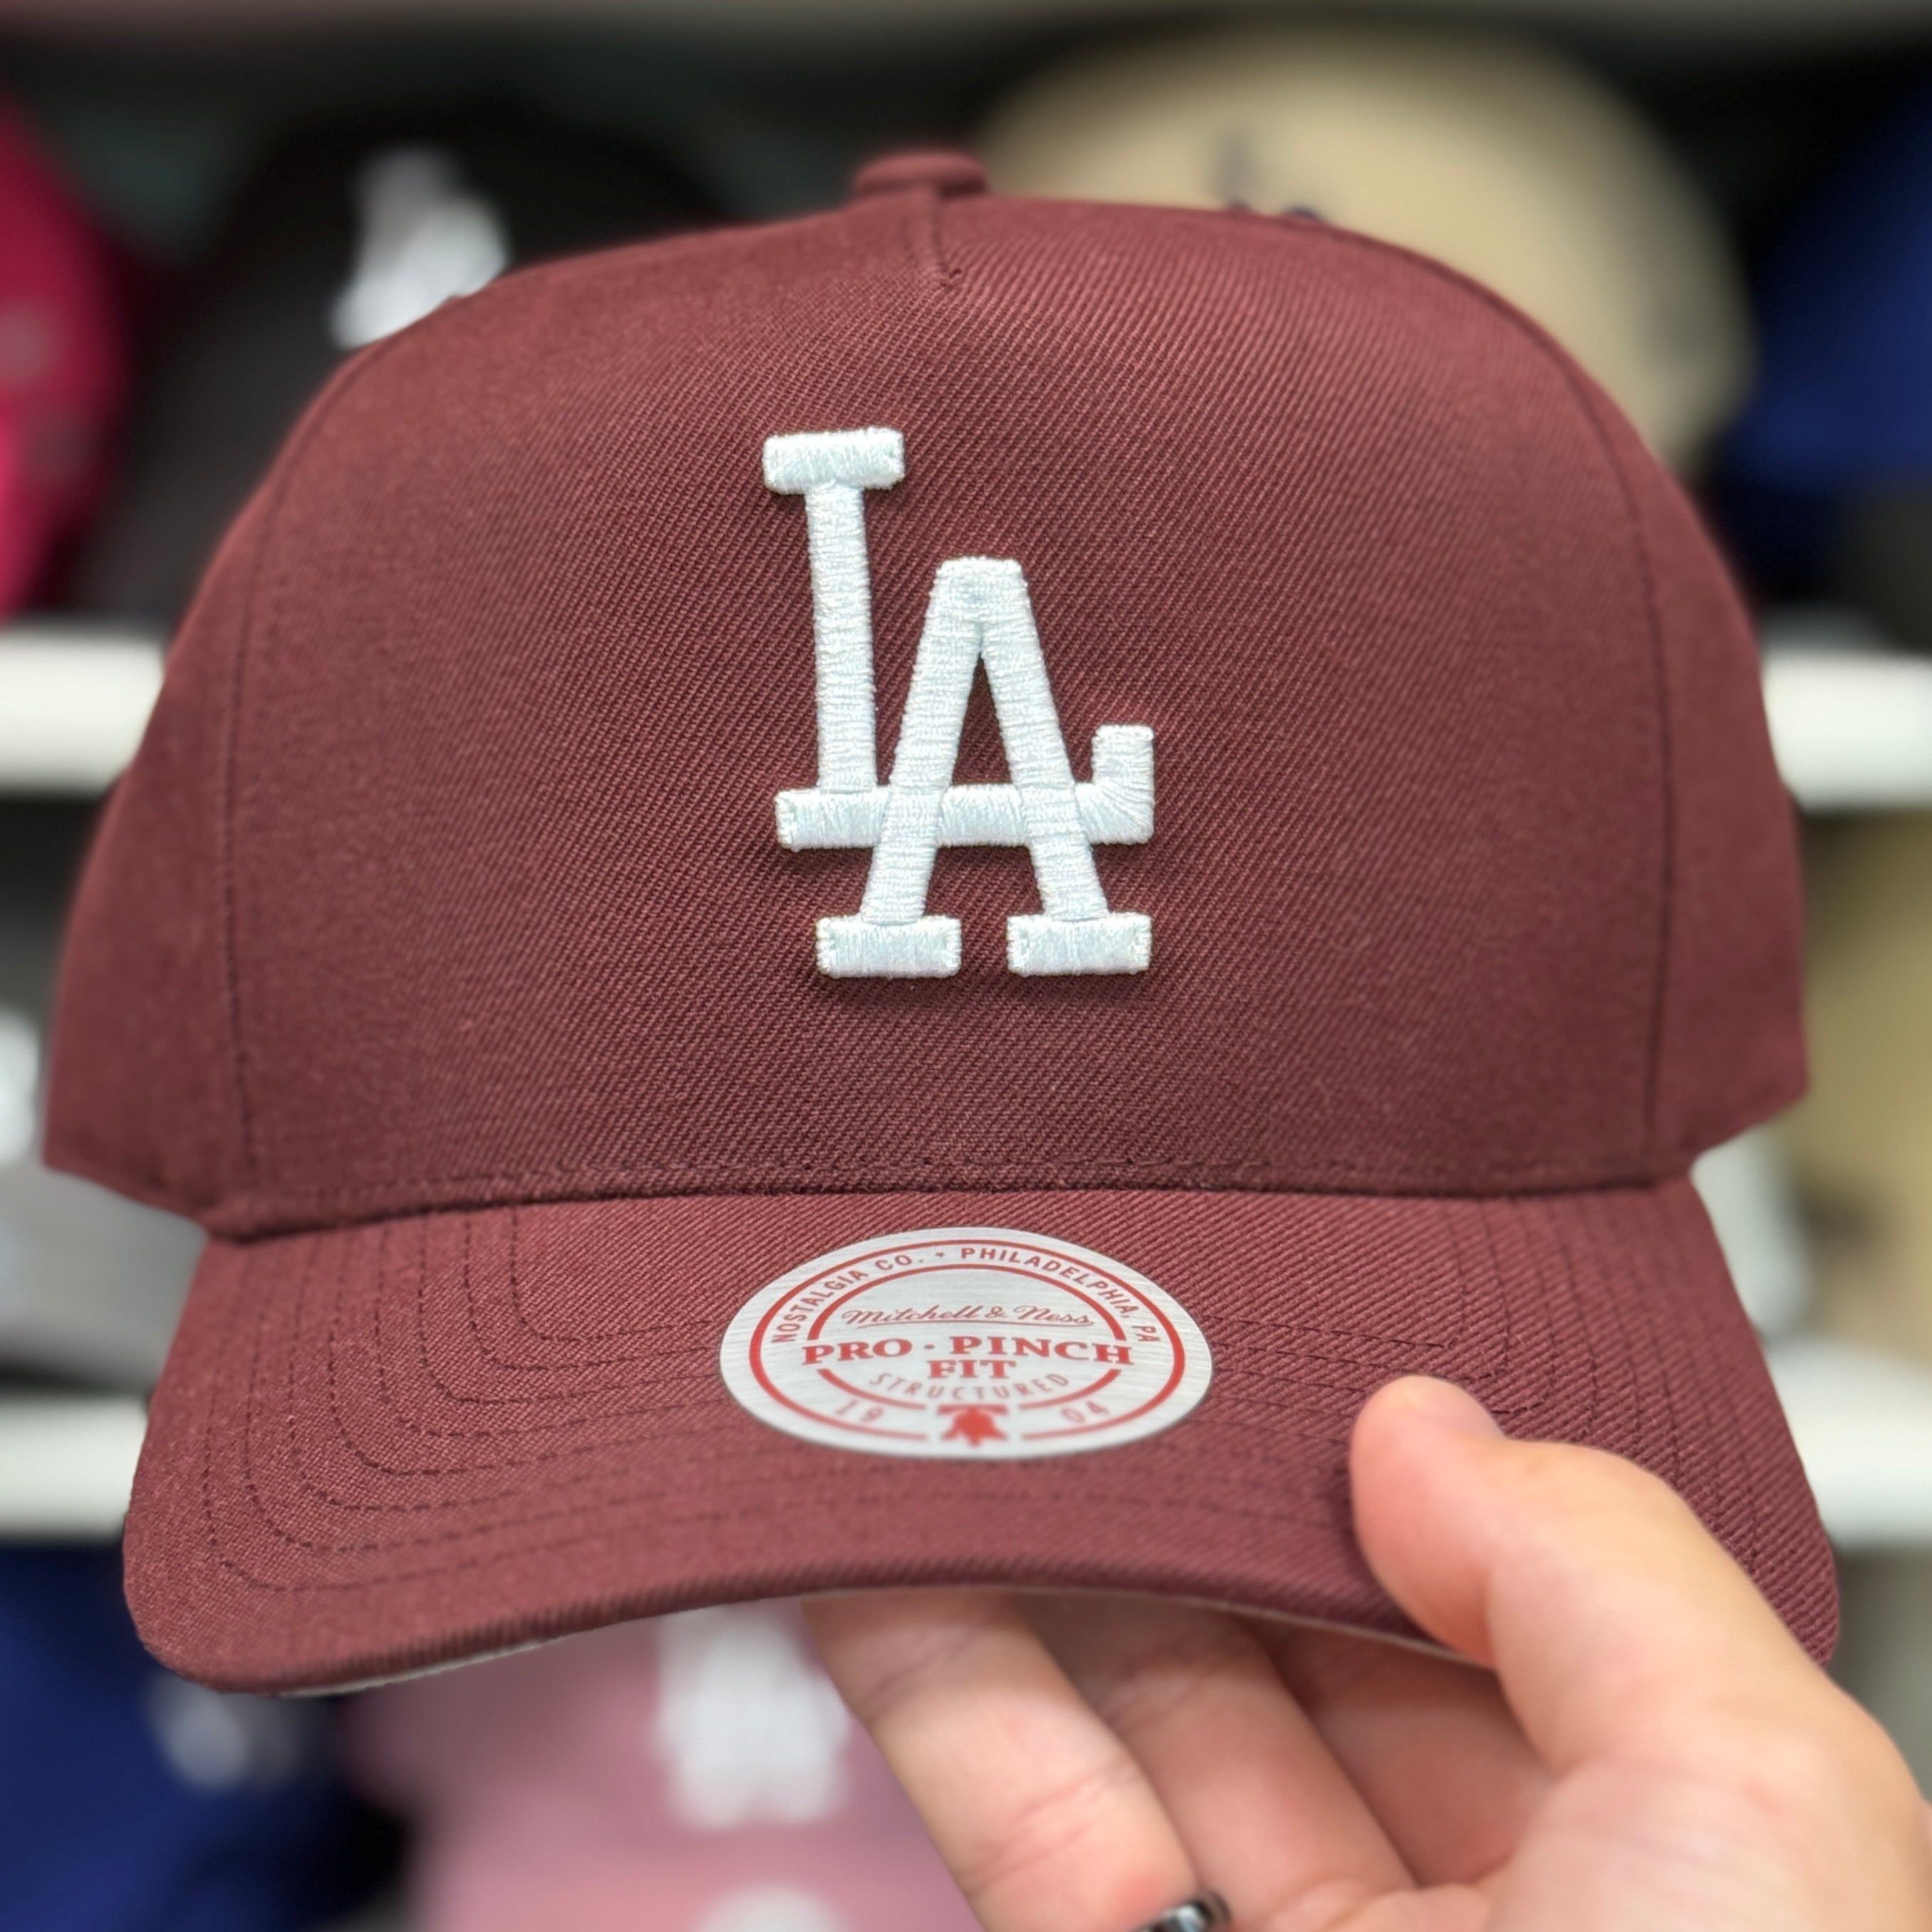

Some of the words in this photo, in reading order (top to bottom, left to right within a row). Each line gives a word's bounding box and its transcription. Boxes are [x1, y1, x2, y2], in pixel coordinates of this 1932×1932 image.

[762, 426, 1155, 979] LA
[771, 1269, 869, 1344] NOSTALGIA
[874, 1254, 924, 1272] CO.
[960, 1247, 1139, 1319] PHILADELPHIA,
[1131, 1324, 1161, 1343] PA
[841, 1304, 983, 1324] Mitchell
[985, 1305, 1007, 1318] &
[1013, 1305, 1091, 1323] Ness
[801, 1338, 913, 1365] PRO
[949, 1336, 1135, 1366] PINCH
[926, 1359, 1017, 1379] FIT
[868, 1373, 1069, 1400] STRUCTURED
[834, 1400, 884, 1423] 19
[1061, 1400, 1109, 1423] 04
